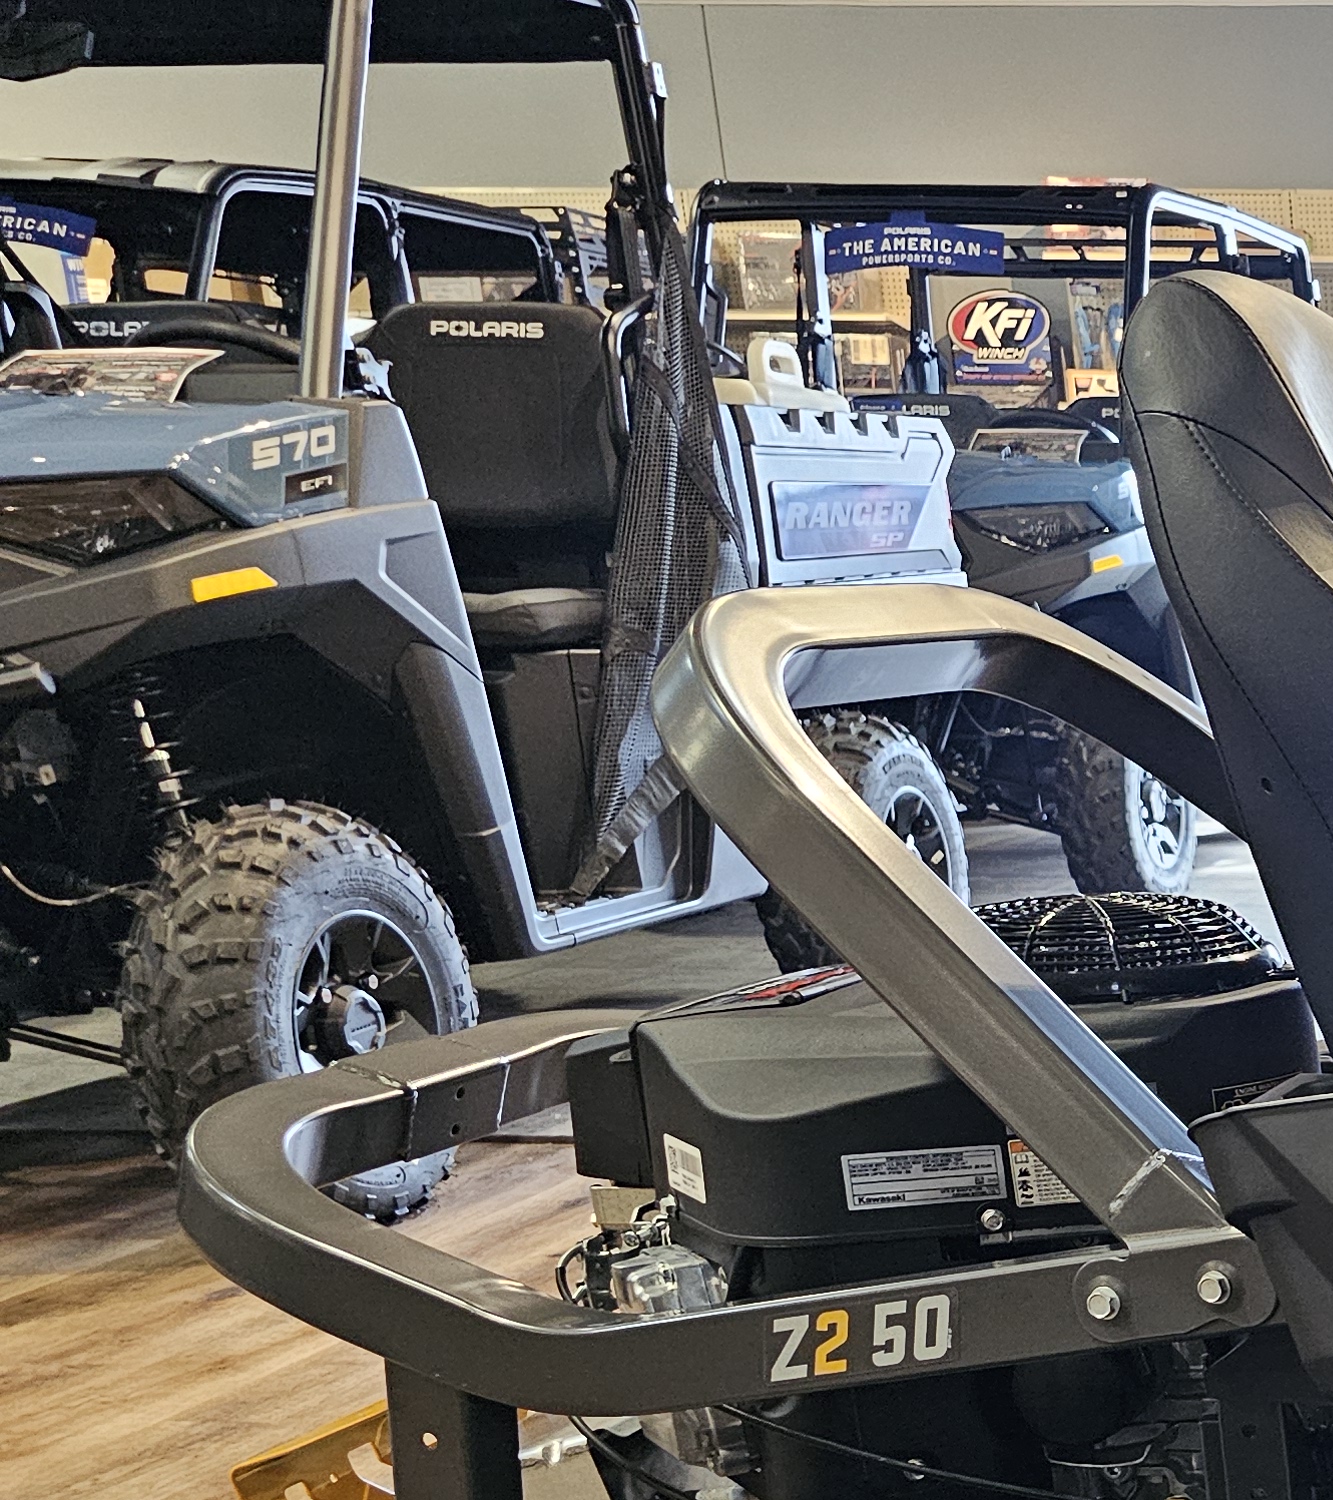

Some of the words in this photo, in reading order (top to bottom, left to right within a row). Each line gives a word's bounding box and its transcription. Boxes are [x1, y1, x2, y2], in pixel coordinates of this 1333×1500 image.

[842, 239, 875, 257] THE
[880, 237, 981, 257] AMERICAN
[862, 253, 934, 266] POWERSPORTS
[430, 320, 544, 339] POLARIS
[978, 347, 1025, 359] WINCH
[252, 424, 335, 471] 570
[785, 500, 911, 530] RANGER
[869, 532, 905, 548] SP
[857, 1194, 906, 1205] Kawasaki
[770, 1309, 850, 1382] Z2
[872, 1294, 951, 1367] 50
